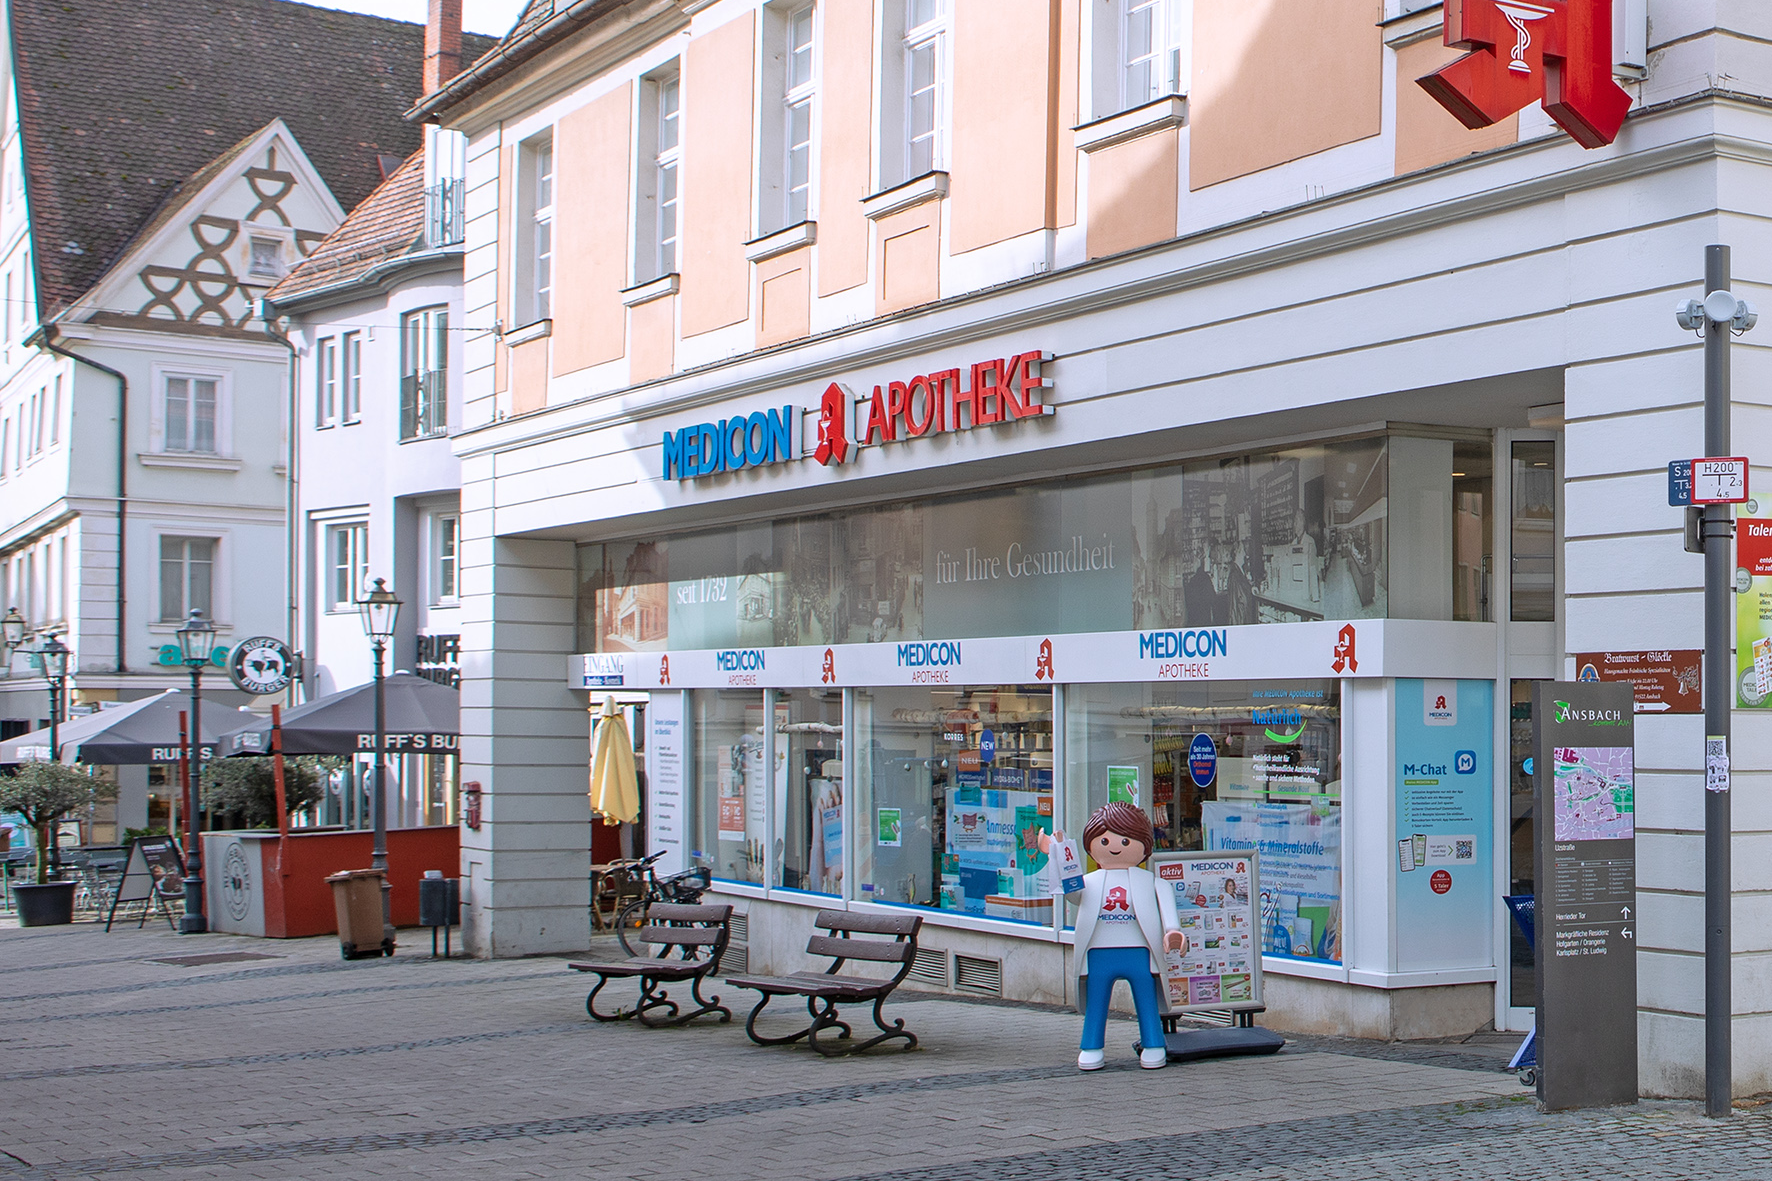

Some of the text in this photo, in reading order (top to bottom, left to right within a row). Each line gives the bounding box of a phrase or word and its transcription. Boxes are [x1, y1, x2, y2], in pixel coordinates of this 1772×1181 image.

[662, 349, 1052, 481] MEDICON APOTHEKE
[935, 532, 1117, 585] für Ihre Gesundheit
[676, 574, 728, 605] seit 1732
[1139, 628, 1228, 660] MEDICON
[716, 650, 766, 671] MEDICON
[897, 641, 962, 667] MEDICON
[911, 670, 949, 684] APOTHEKE
[1158, 663, 1209, 679] APOTHEKE
[241, 674, 290, 692] BURGER
[728, 674, 757, 686] APOTHEKE
[1252, 708, 1302, 725] Natürlich
[1560, 706, 1621, 720] ANSBACH
[981, 741, 995, 751] NEW
[1403, 763, 1448, 776] M-Chat
[1039, 803, 1051, 811] NEU
[1267, 840, 1324, 856] Mineralstoffe
[1161, 867, 1182, 876] aktiv
[1191, 861, 1234, 871] MEDICON
[1097, 913, 1137, 921] MEDICON
